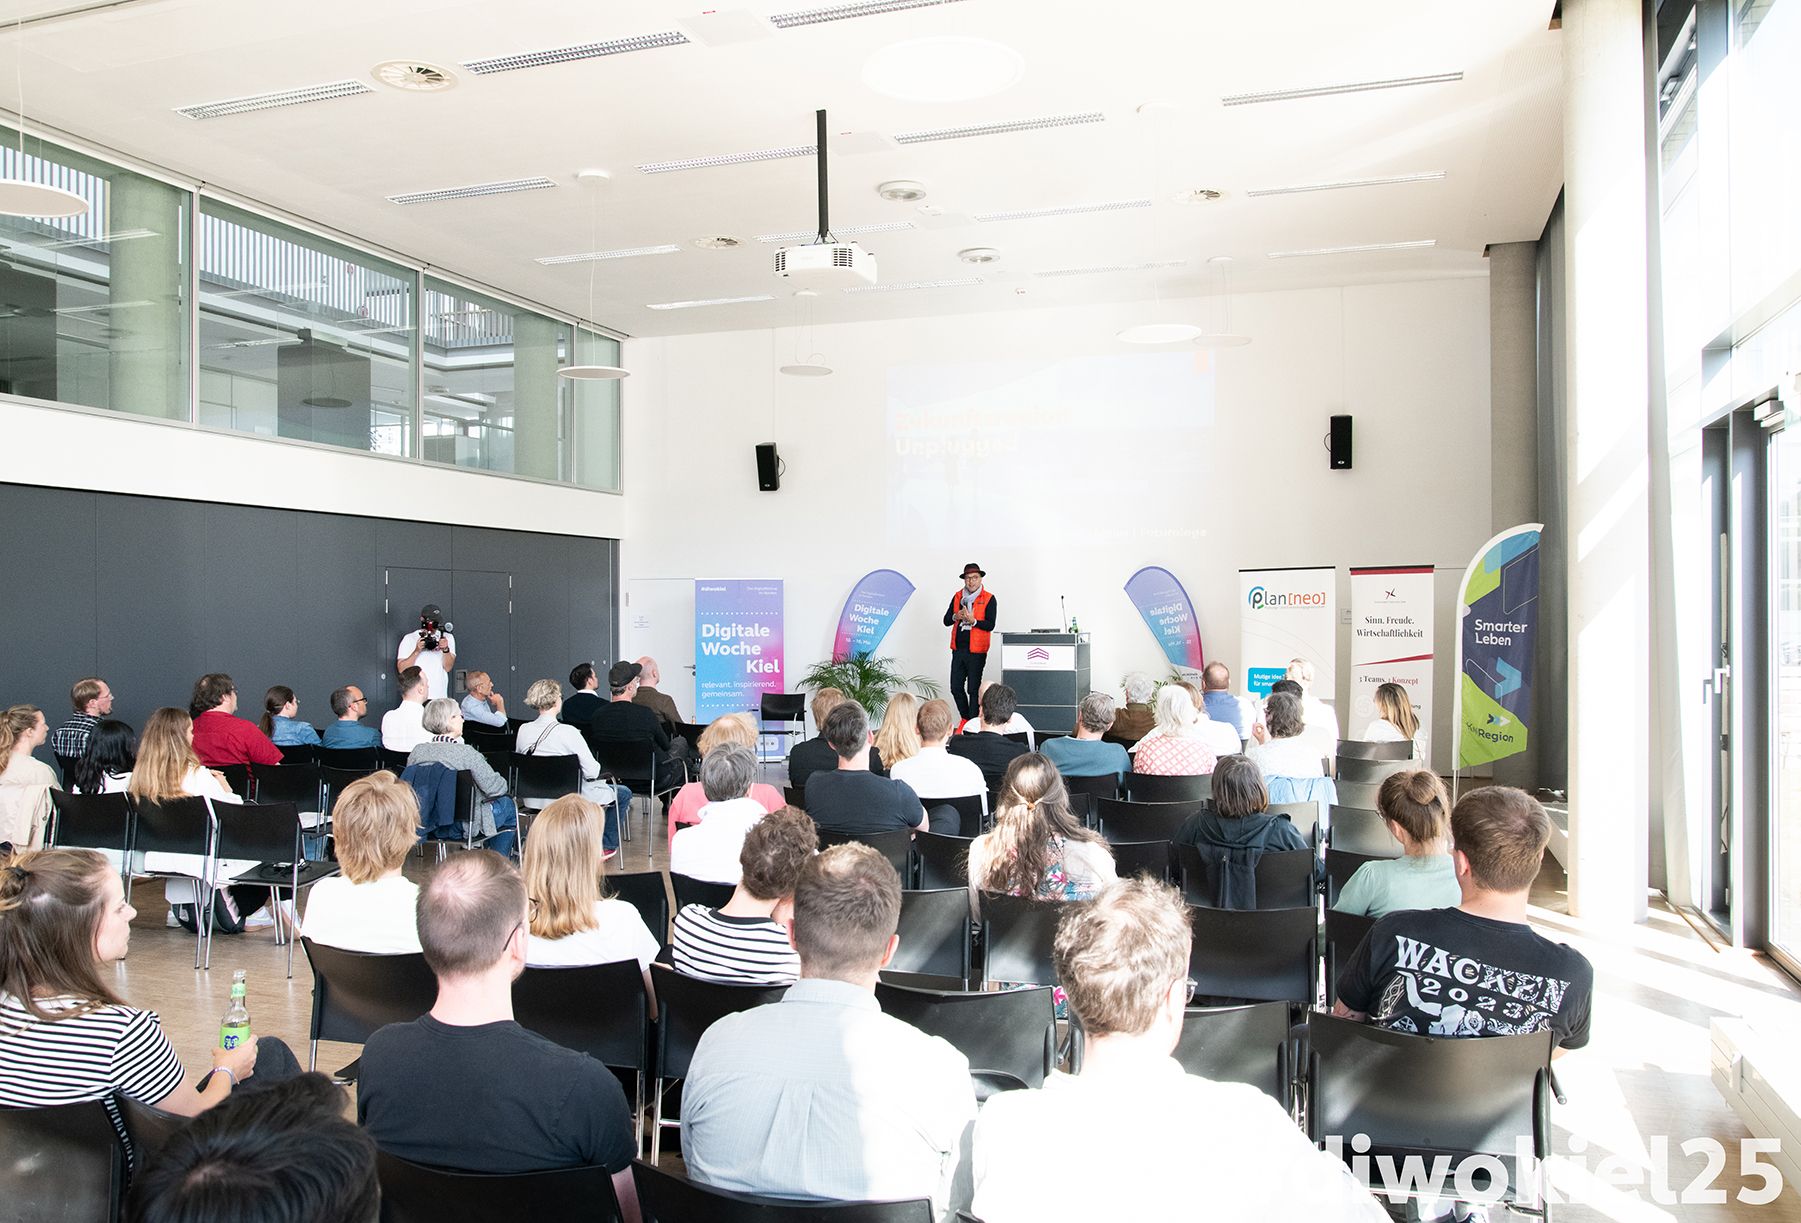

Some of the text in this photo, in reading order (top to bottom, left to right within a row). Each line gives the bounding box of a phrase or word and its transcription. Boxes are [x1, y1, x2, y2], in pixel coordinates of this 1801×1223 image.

[854, 603, 890, 617] Digitale
[849, 613, 880, 625] Woche
[1365, 616, 1415, 625] Sinn. Freude.
[1475, 618, 1528, 633] Smarter
[701, 623, 770, 641] Digitale
[856, 624, 875, 635] Kiel
[1356, 628, 1424, 638] Wirtschaftlichkeit
[1475, 632, 1512, 646] Leben
[701, 641, 761, 656] Woche
[746, 659, 780, 673] Kiel
[734, 680, 777, 690] inspirierend.
[1392, 677, 1419, 686] Konzept
[701, 691, 745, 699] gemeinsam.
[1394, 934, 1572, 1014] WACKEN
[1421, 978, 1525, 1019] 2023
